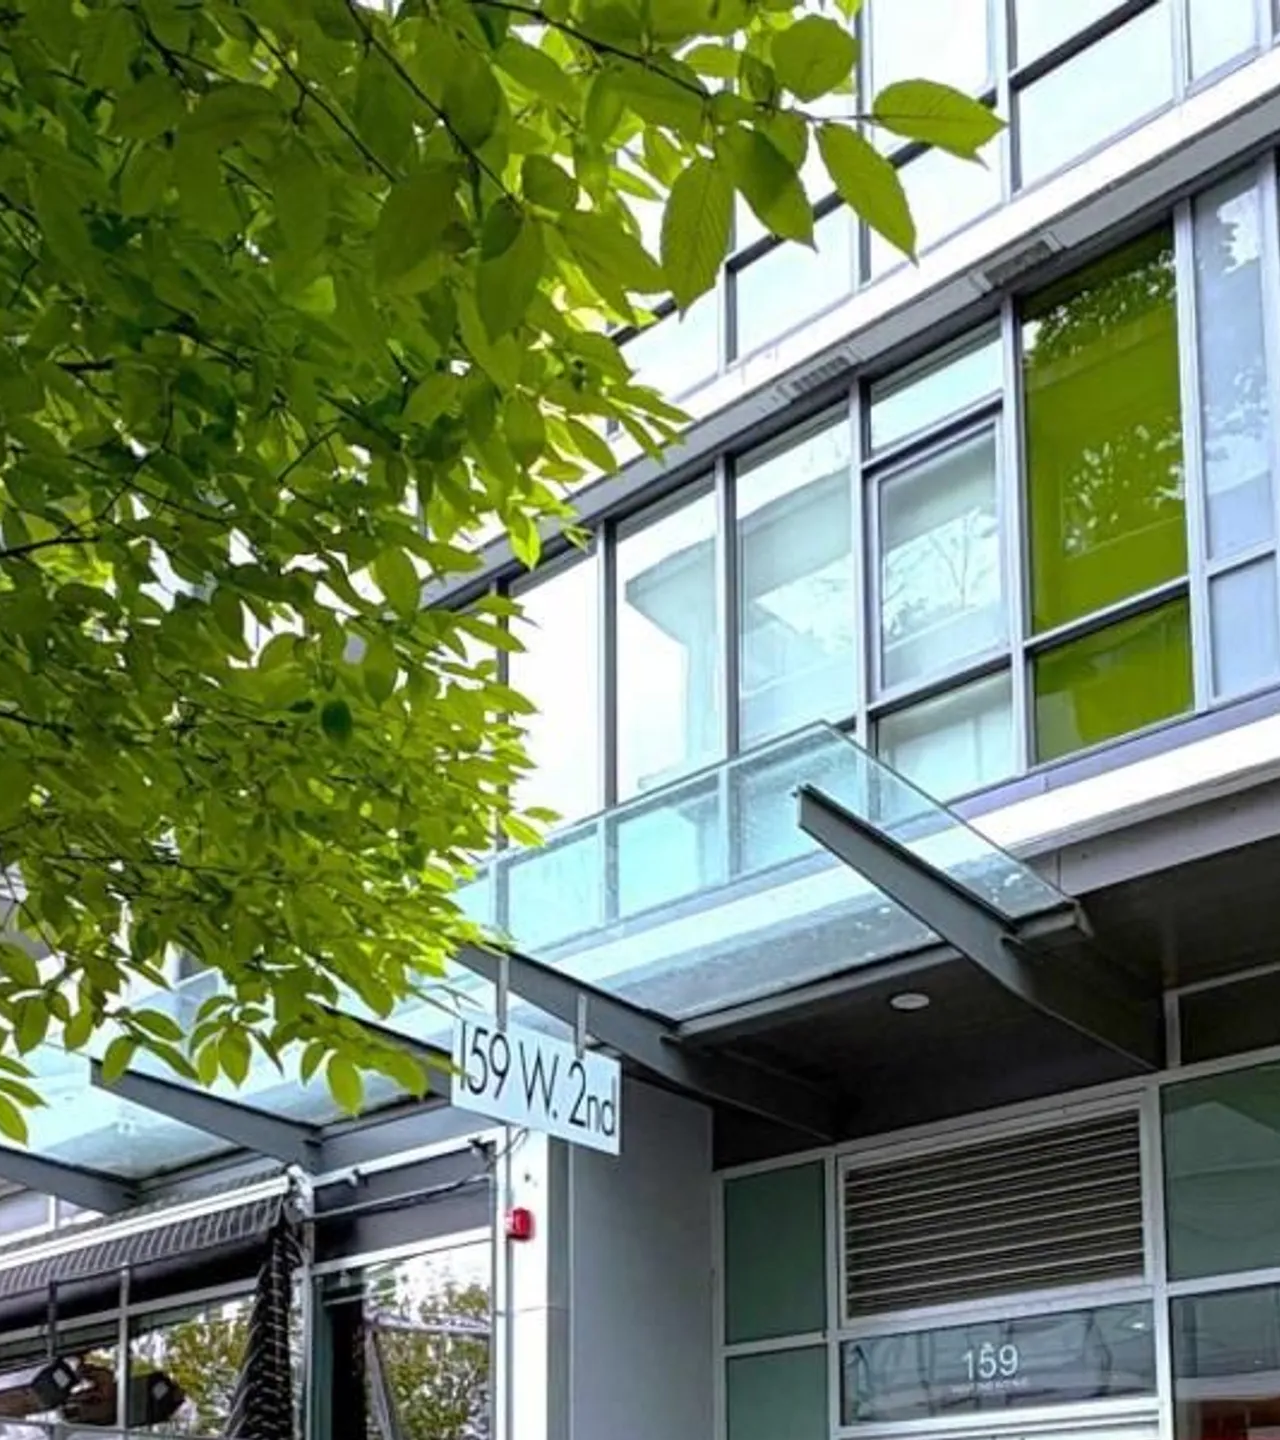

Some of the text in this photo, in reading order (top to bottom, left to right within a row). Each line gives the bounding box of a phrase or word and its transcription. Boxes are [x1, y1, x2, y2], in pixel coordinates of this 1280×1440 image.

[460, 1020, 617, 1136] 159 W. 2nd
[961, 1344, 1018, 1380] 159
